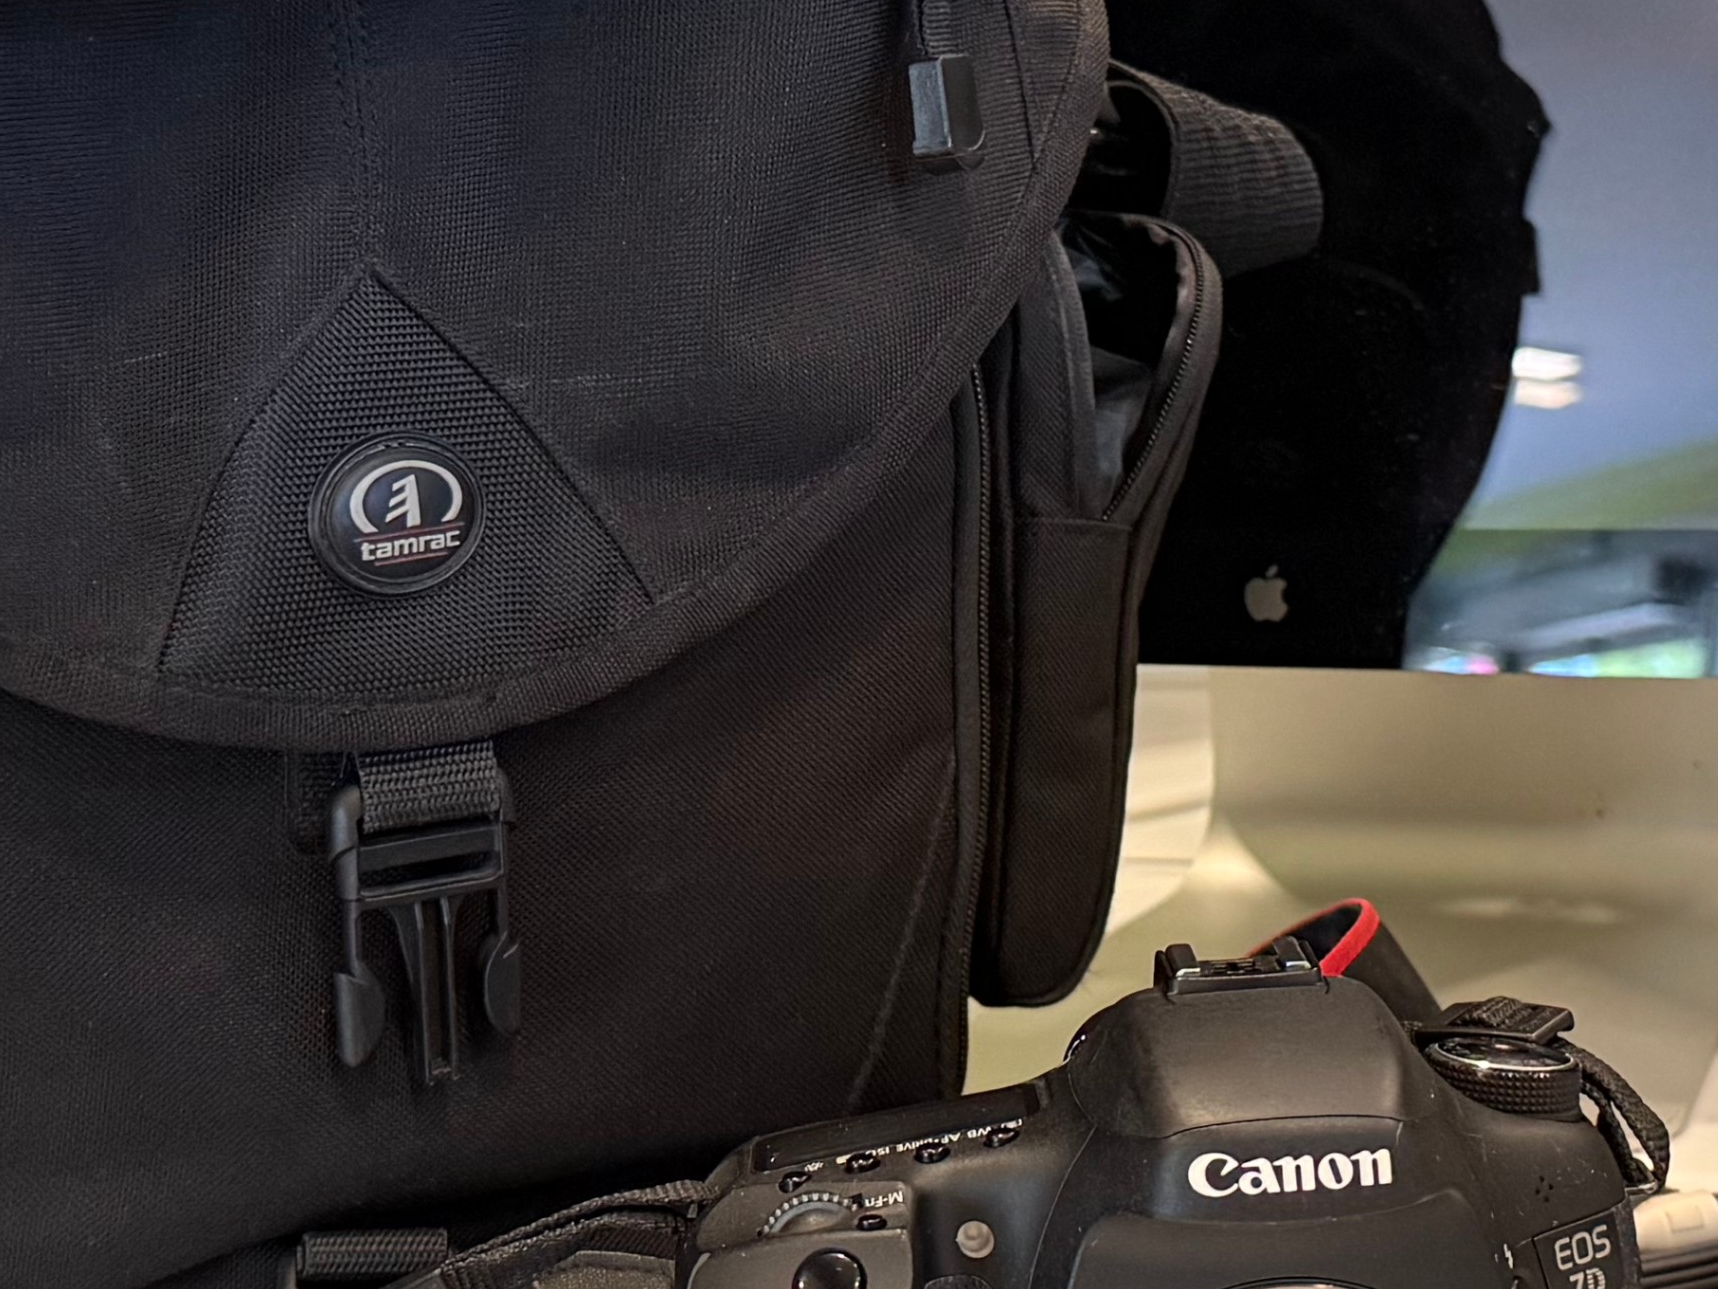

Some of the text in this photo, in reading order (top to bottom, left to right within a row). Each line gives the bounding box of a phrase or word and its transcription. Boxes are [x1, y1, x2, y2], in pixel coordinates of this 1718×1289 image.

[360, 529, 461, 561] tamrac
[1187, 1148, 1393, 1198] Canon
[864, 1190, 903, 1208] M-Fn
[1554, 1224, 1611, 1271] EOS
